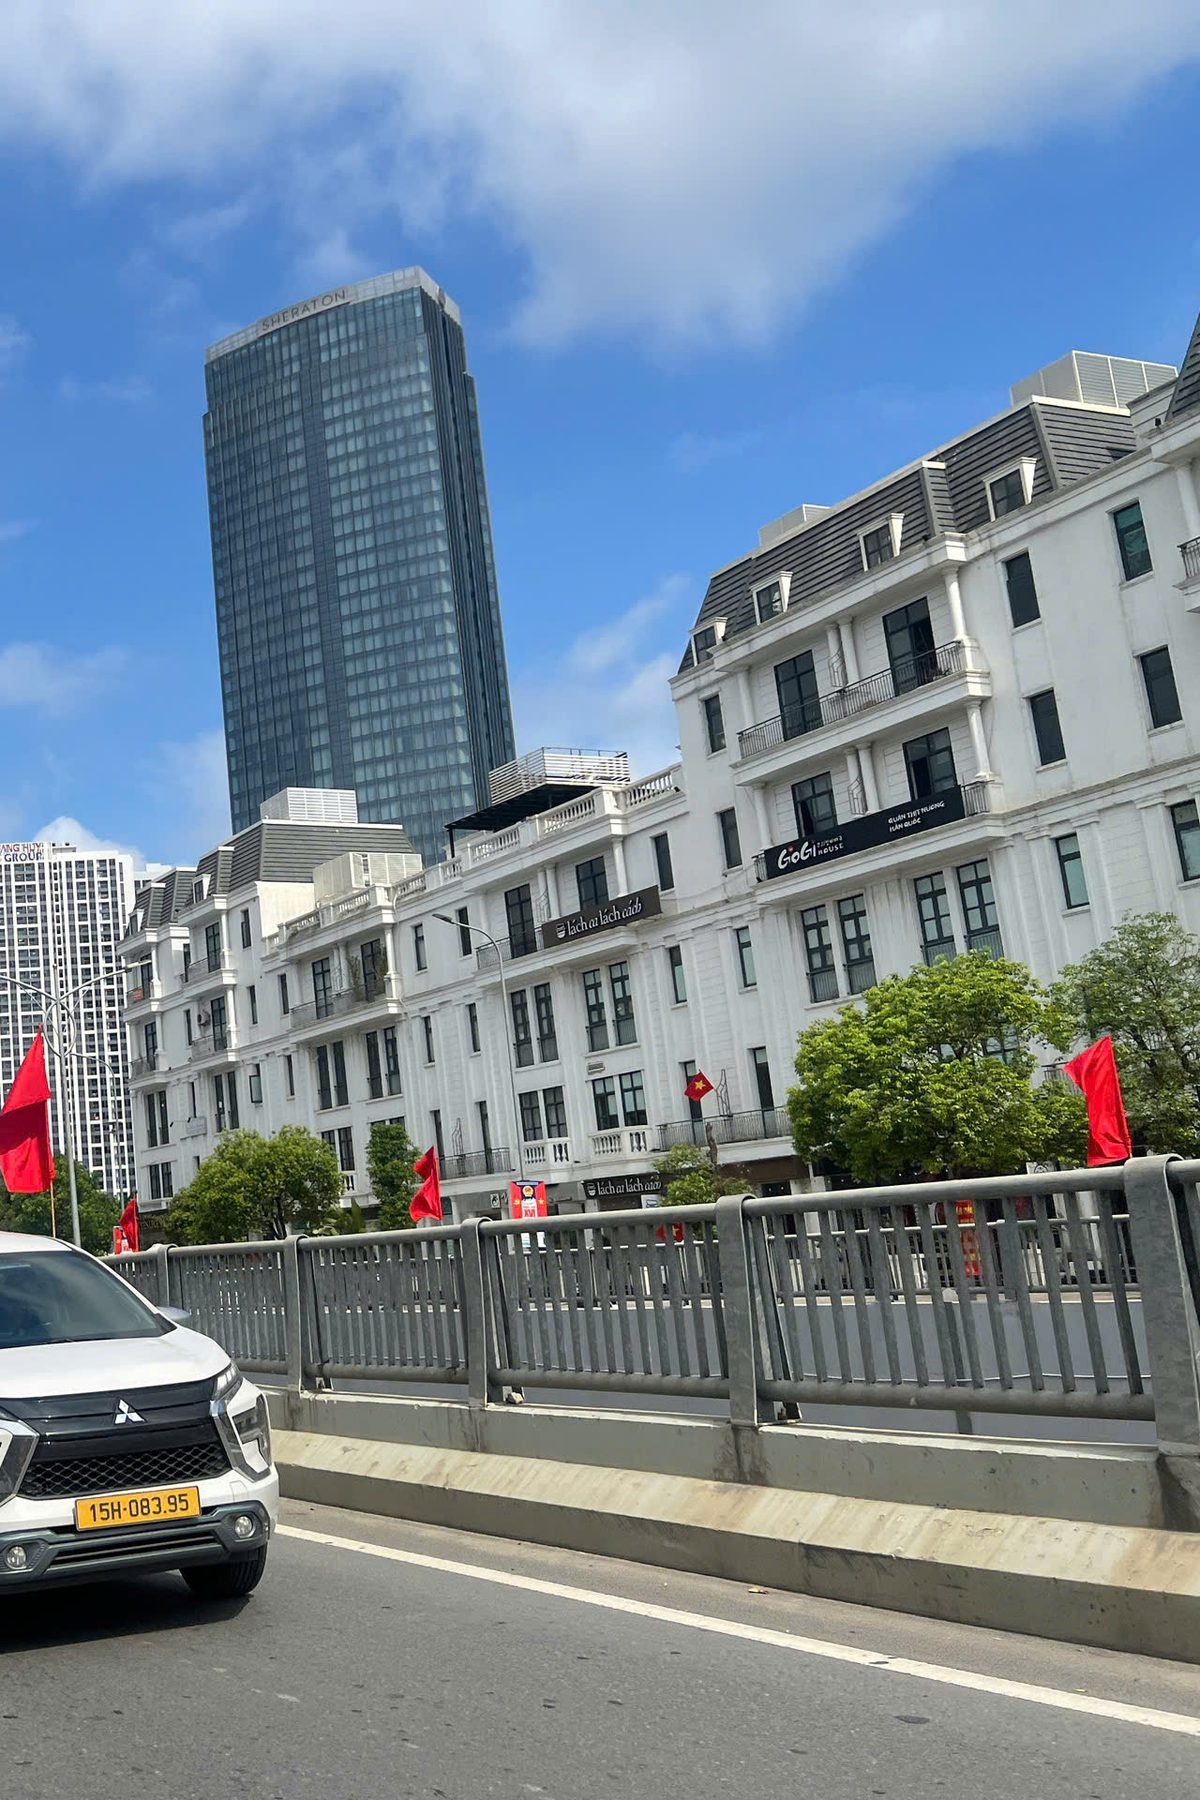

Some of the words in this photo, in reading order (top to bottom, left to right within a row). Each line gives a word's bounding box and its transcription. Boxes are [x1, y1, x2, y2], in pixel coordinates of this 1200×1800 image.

[262, 289, 346, 331] SHERATON
[4, 851, 42, 862] GROUP
[818, 843, 844, 856] HOUSE
[567, 915, 589, 936] lách
[599, 905, 621, 926] lách
[597, 1180, 616, 1195] lách
[625, 1177, 644, 1192] lách
[90, 1493, 189, 1522] 15H-083.95
